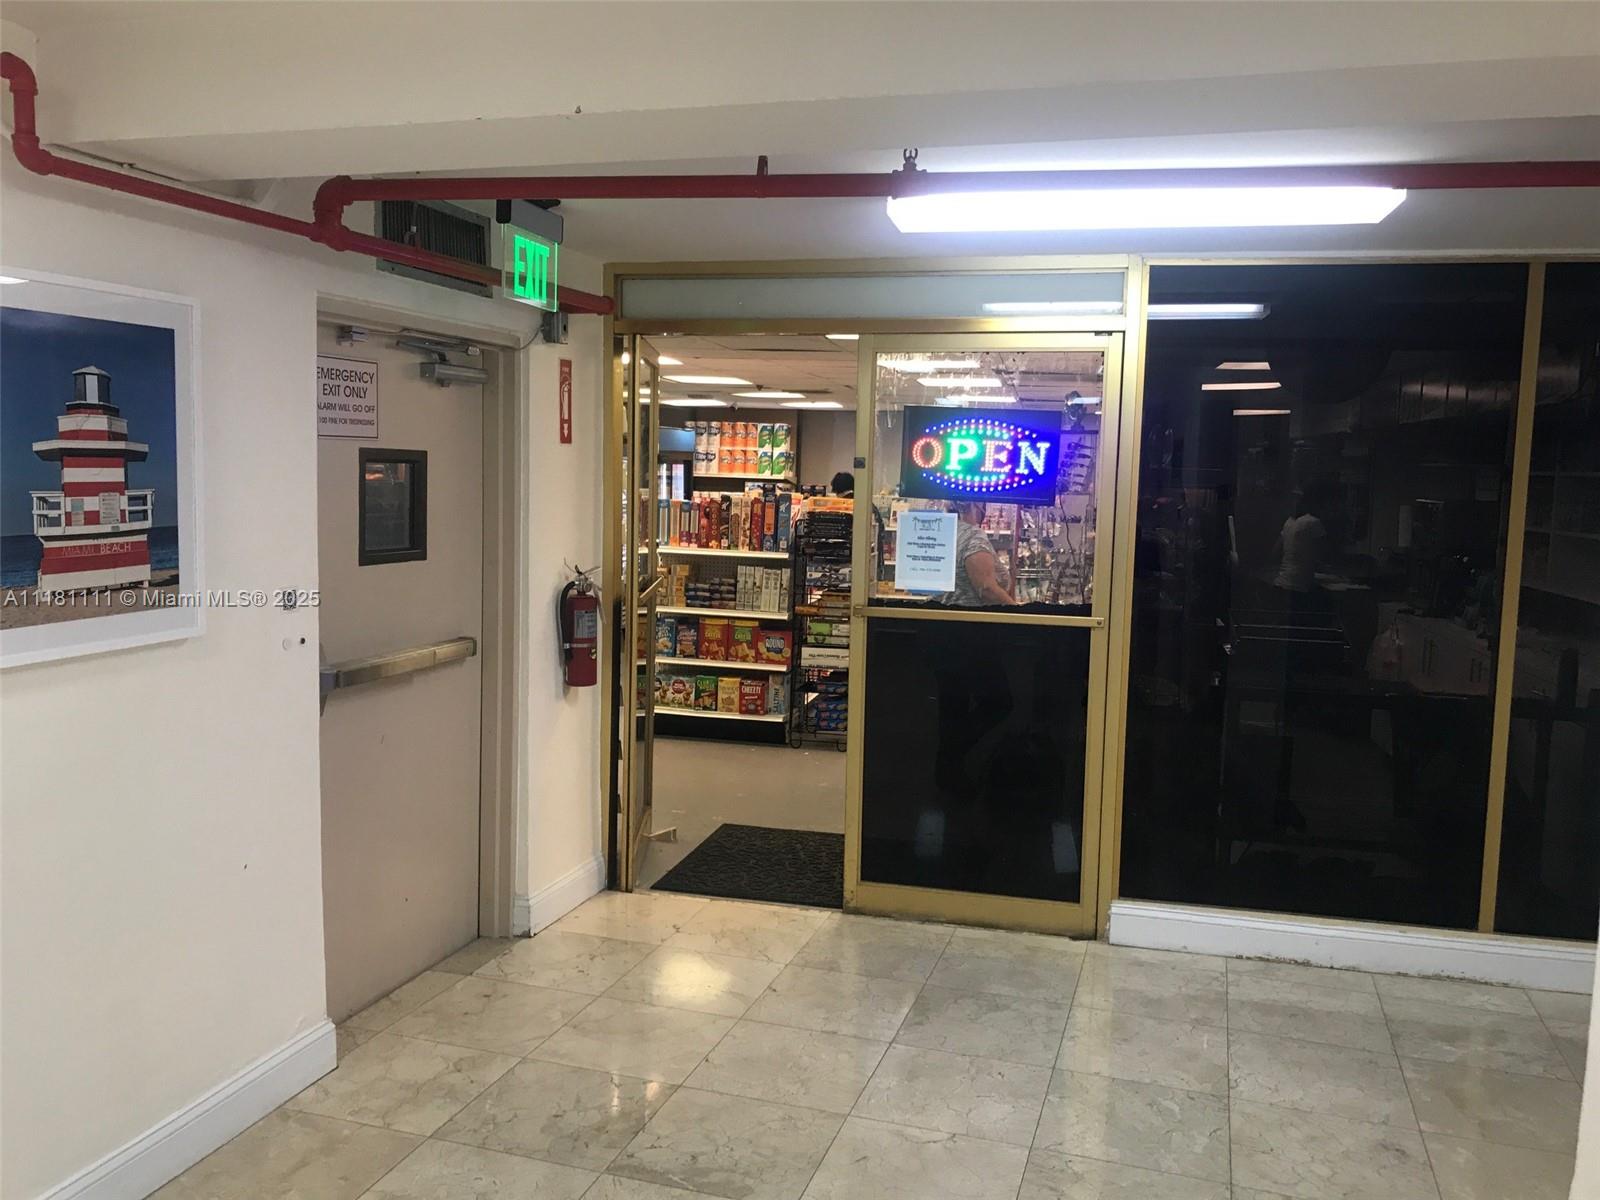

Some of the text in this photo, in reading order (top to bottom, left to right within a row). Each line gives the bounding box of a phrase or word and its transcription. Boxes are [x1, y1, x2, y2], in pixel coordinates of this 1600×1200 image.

[513, 235, 550, 304] EXIT
[317, 367, 374, 384] EMERGENCY
[322, 384, 368, 399] EXIT ONLY
[337, 403, 351, 412] WILL
[352, 404, 363, 412] GO
[364, 405, 375, 413] OFF
[912, 436, 1051, 476] OPEN
[62, 542, 131, 556] MIAMI BEACH
